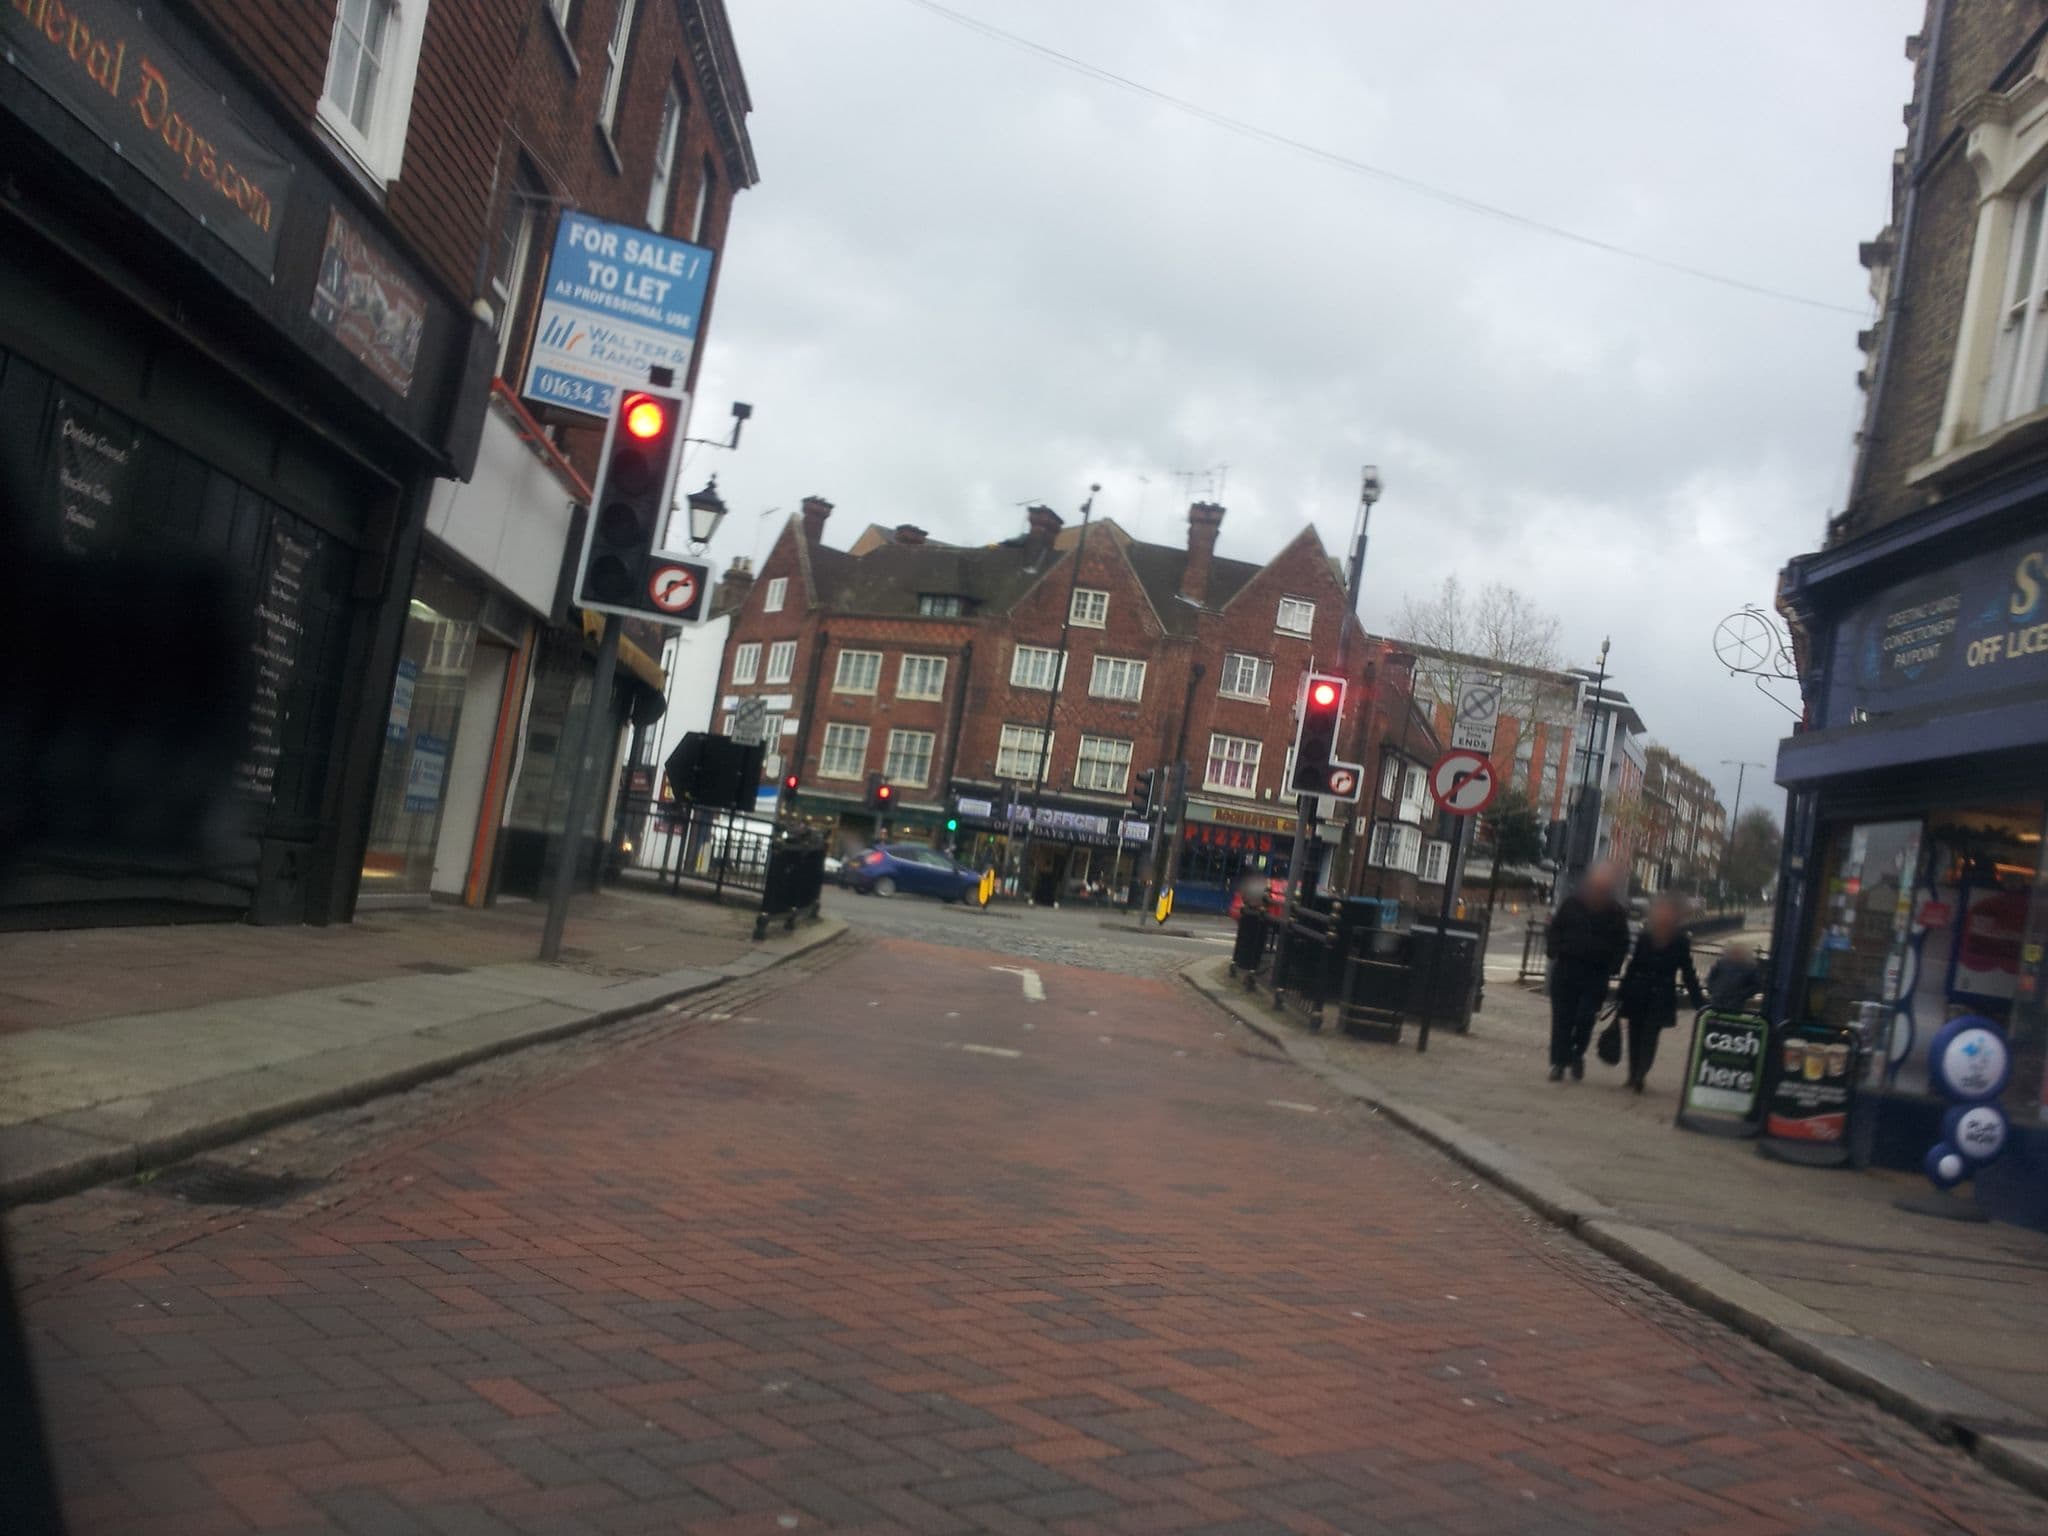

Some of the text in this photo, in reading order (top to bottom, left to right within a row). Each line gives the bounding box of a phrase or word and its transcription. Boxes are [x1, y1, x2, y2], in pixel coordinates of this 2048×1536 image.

[568, 222, 699, 281] FOR SALE /
[587, 259, 672, 304] TO LET
[555, 279, 692, 330] A2 PROFESSIONAL USE
[588, 325, 686, 365] WALTER &
[540, 373, 594, 405] 01634
[1884, 618, 1957, 651] CONFECTIONERY
[1894, 642, 1942, 669] PAYPOINT
[1966, 635, 2004, 668] OFF
[1458, 737, 1487, 749] ENDS
[1184, 823, 1272, 853] PIZZAS
[1704, 1031, 1761, 1057] cash
[1697, 1058, 1755, 1090] here
